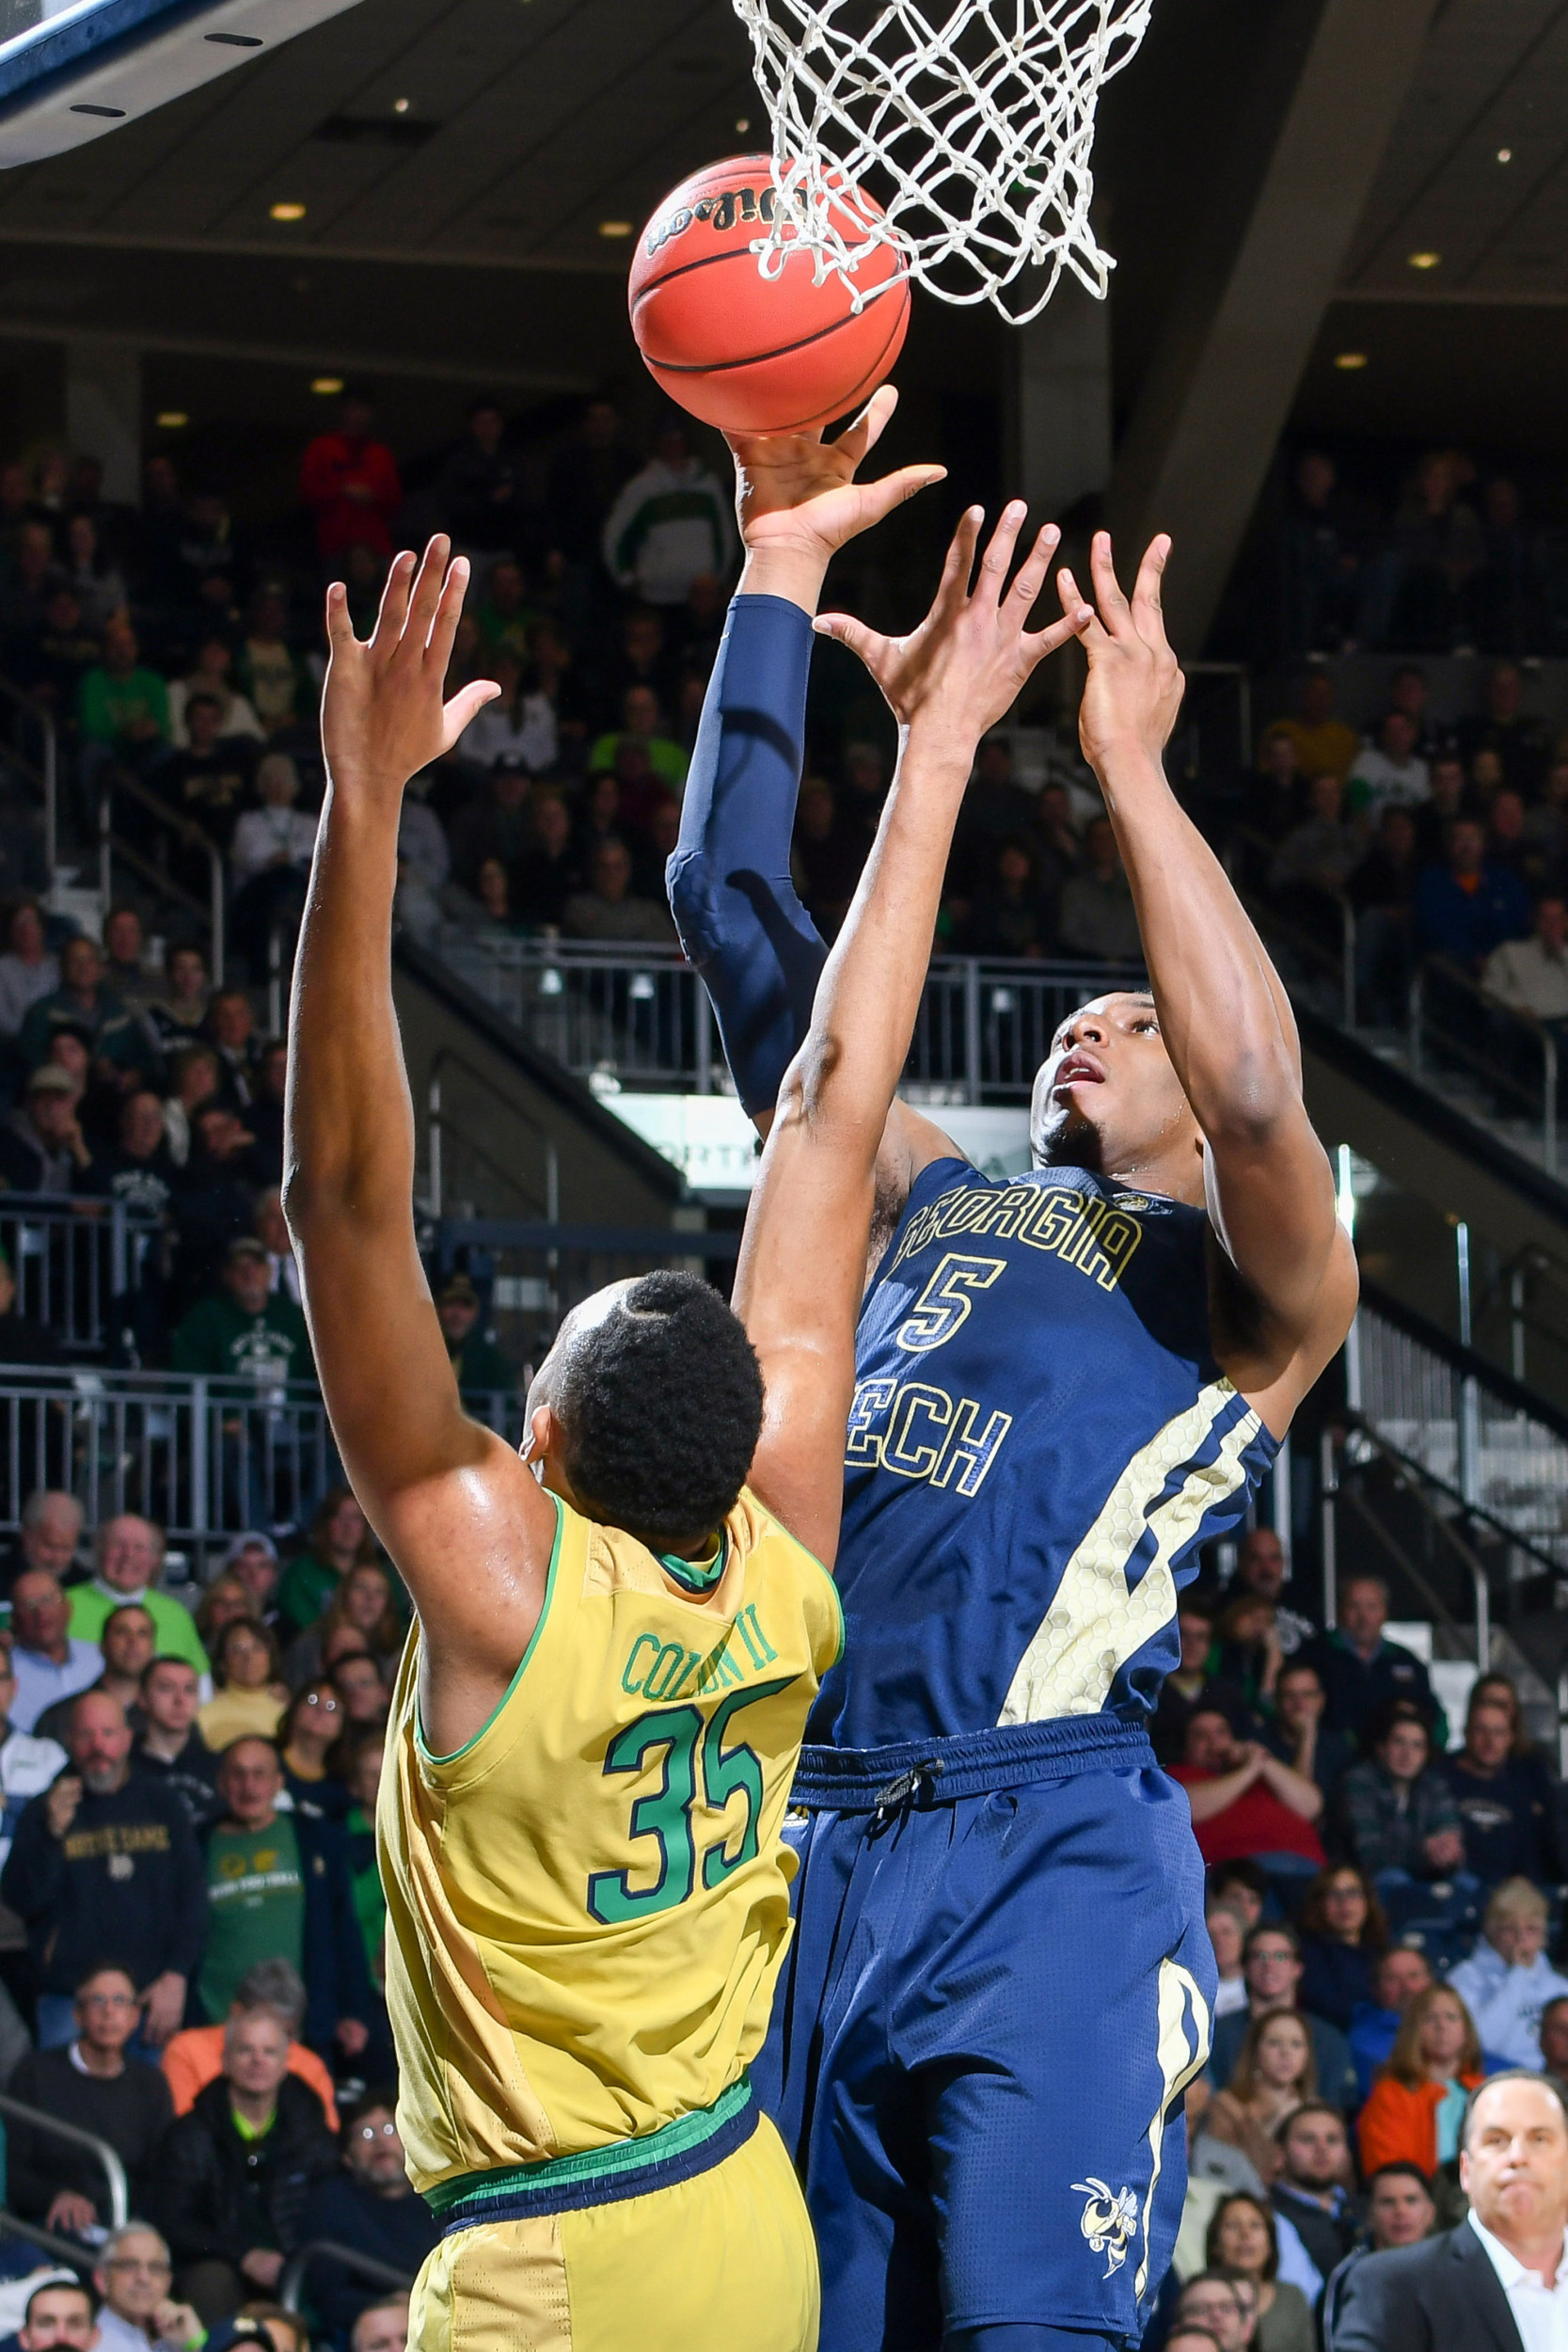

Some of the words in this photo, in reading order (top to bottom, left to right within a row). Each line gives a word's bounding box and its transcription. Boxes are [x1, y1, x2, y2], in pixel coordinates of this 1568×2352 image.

[645, 187, 811, 256] Wilson
[896, 1253, 1007, 1353] 5
[844, 1378, 1013, 1498] ECH
[587, 1675, 804, 1926] 35
